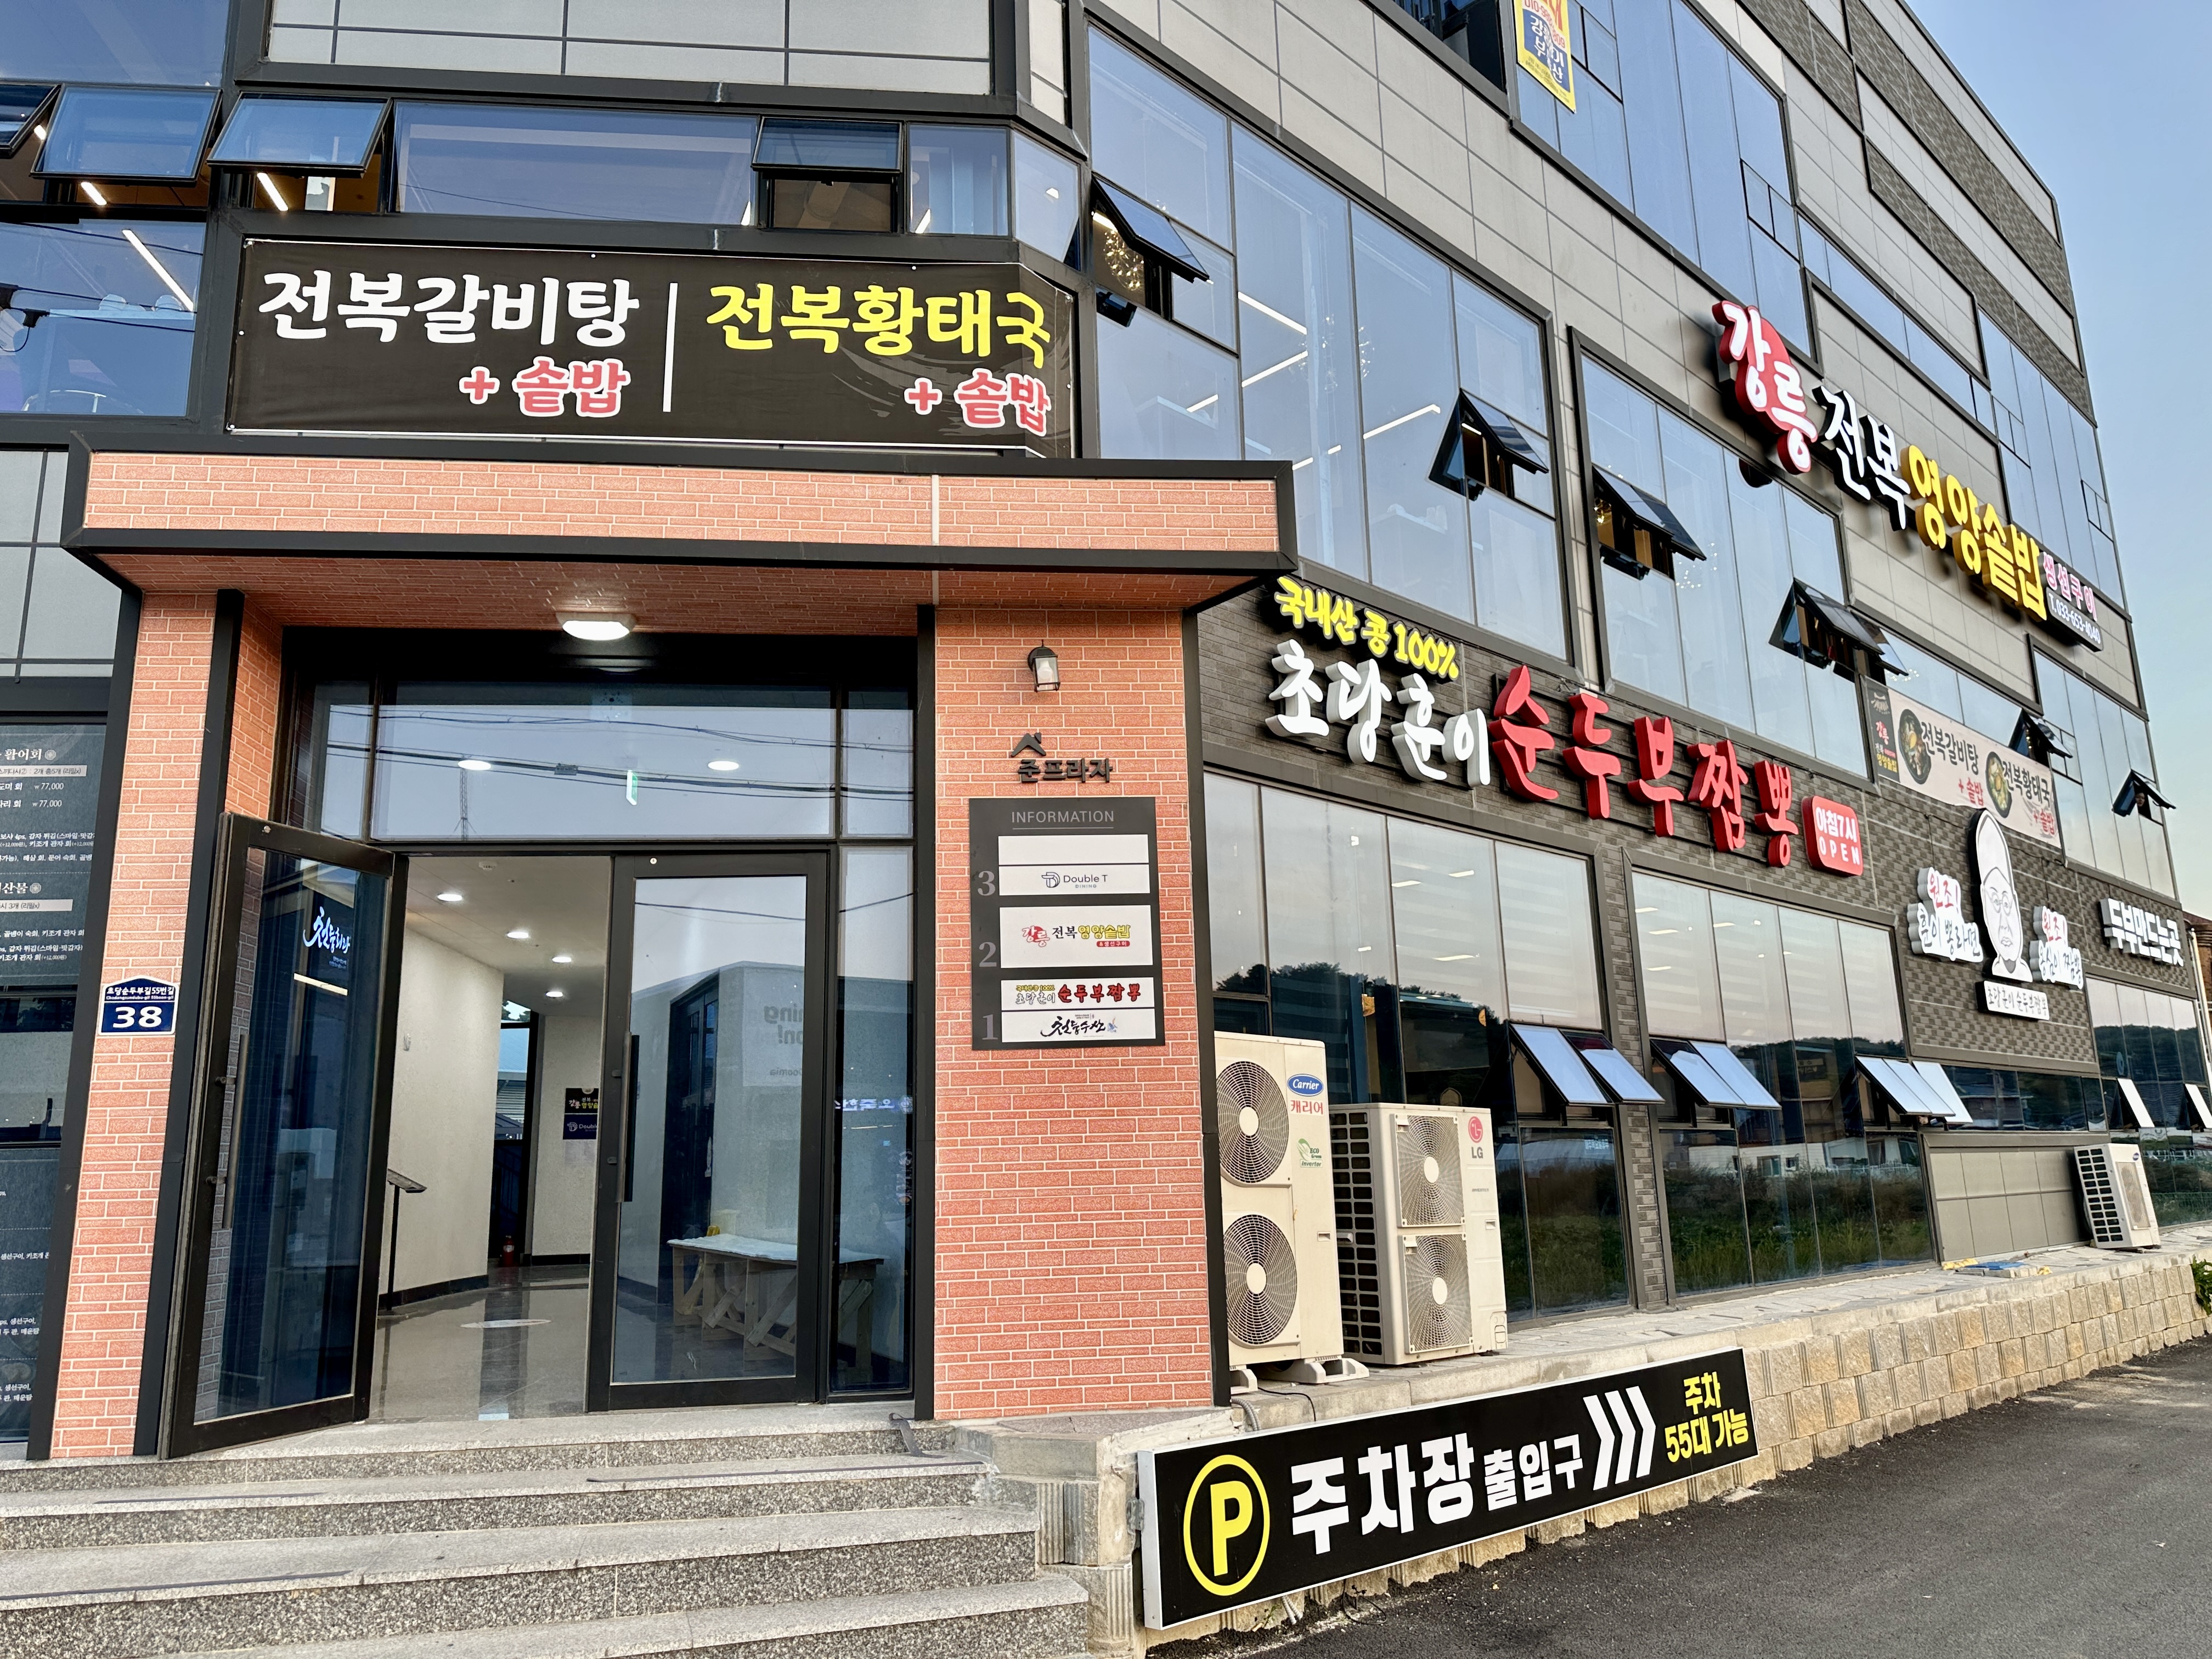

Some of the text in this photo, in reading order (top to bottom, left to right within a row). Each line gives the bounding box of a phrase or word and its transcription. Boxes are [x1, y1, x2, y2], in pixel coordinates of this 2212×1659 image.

[258, 270, 640, 348] 전복갈비탕
[706, 282, 1052, 368] 전복황태국
[512, 357, 631, 418] 솥밥
[957, 366, 1052, 437] 솥밥
[1722, 301, 1818, 473] 강릉
[1815, 385, 2047, 620] 전복 영양솥밥
[2043, 551, 2097, 622] 생선구이
[1274, 576, 1459, 679] 국내산 콩 100%
[1921, 721, 1979, 775] 전복갈비탕
[1018, 758, 1114, 783] 준프라자
[1488, 665, 1799, 867] 순두부짬뽕
[14, 782, 22, 791] 회
[1967, 777, 1984, 806] 솥밥
[2002, 761, 2050, 808] 전복황태국
[13, 799, 21, 808] 회
[1012, 810, 1114, 823] INFORMATION
[1815, 806, 1858, 843] 아침7시
[2040, 809, 2055, 835] 솥밥
[1819, 836, 1860, 866] OPEN
[0, 882, 28, 894] 산물
[977, 871, 996, 895] 3
[1063, 874, 1108, 883] Double T
[1929, 873, 1959, 915] 원조!
[1022, 924, 1131, 947] 강릉 전복 영양솥밥
[2044, 911, 2066, 945] 원조!
[2108, 898, 2184, 967] 두부만드는곳
[978, 941, 997, 968] 2
[1057, 983, 1141, 1003] 순두부짬뽕
[112, 1006, 162, 1028] 38
[981, 1014, 998, 1040] 1
[1292, 1079, 1319, 1091] Carrier
[1290, 1099, 1324, 1115] 캐리어
[1471, 1146, 1483, 1159] LG
[1683, 1371, 1720, 1414] 주차
[1664, 1409, 1750, 1463] 55대 가능
[1210, 1432, 1584, 1577] P 주차장 출입구
